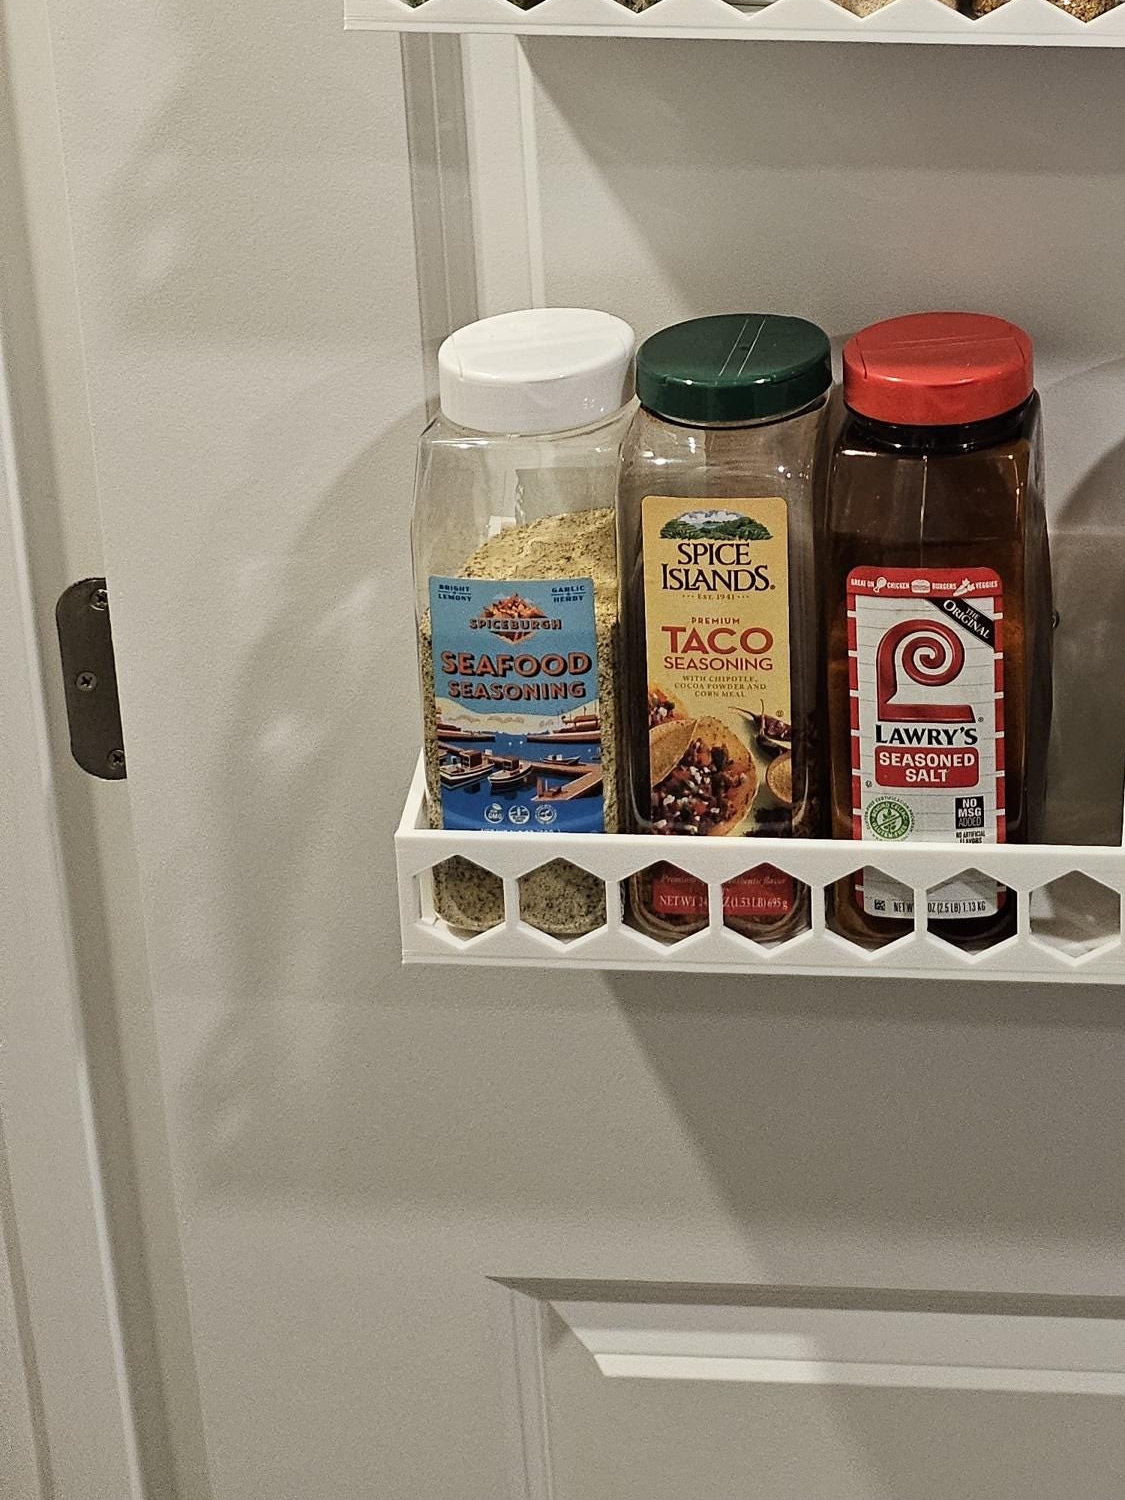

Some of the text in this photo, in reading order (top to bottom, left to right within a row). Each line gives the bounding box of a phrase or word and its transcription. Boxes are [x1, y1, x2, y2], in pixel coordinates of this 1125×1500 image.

[677, 543, 752, 565] SPICE
[661, 564, 770, 591] ISLANDS
[851, 579, 867, 587] GREAT
[439, 584, 469, 592] BRIGHT
[551, 585, 585, 594] GARLIC
[887, 582, 910, 590] CHICKEN
[932, 582, 957, 590] BURGERS
[976, 579, 998, 589] VEGGIES
[439, 593, 472, 602] LEMONY
[469, 618, 562, 630] SPICEBURGH
[943, 600, 990, 639] ORIGINAL
[661, 626, 774, 655] TACO
[442, 652, 592, 677] SEAFOOD
[664, 656, 773, 671] SEASONING
[448, 681, 586, 699] SEASONING
[875, 725, 978, 746] LAWRY'S
[879, 751, 975, 767] SEASONED
[905, 768, 948, 782] SALT
[963, 798, 977, 808] NO
[958, 808, 982, 817] MSG
[958, 817, 982, 827] ADDED
[659, 894, 677, 907] NET
